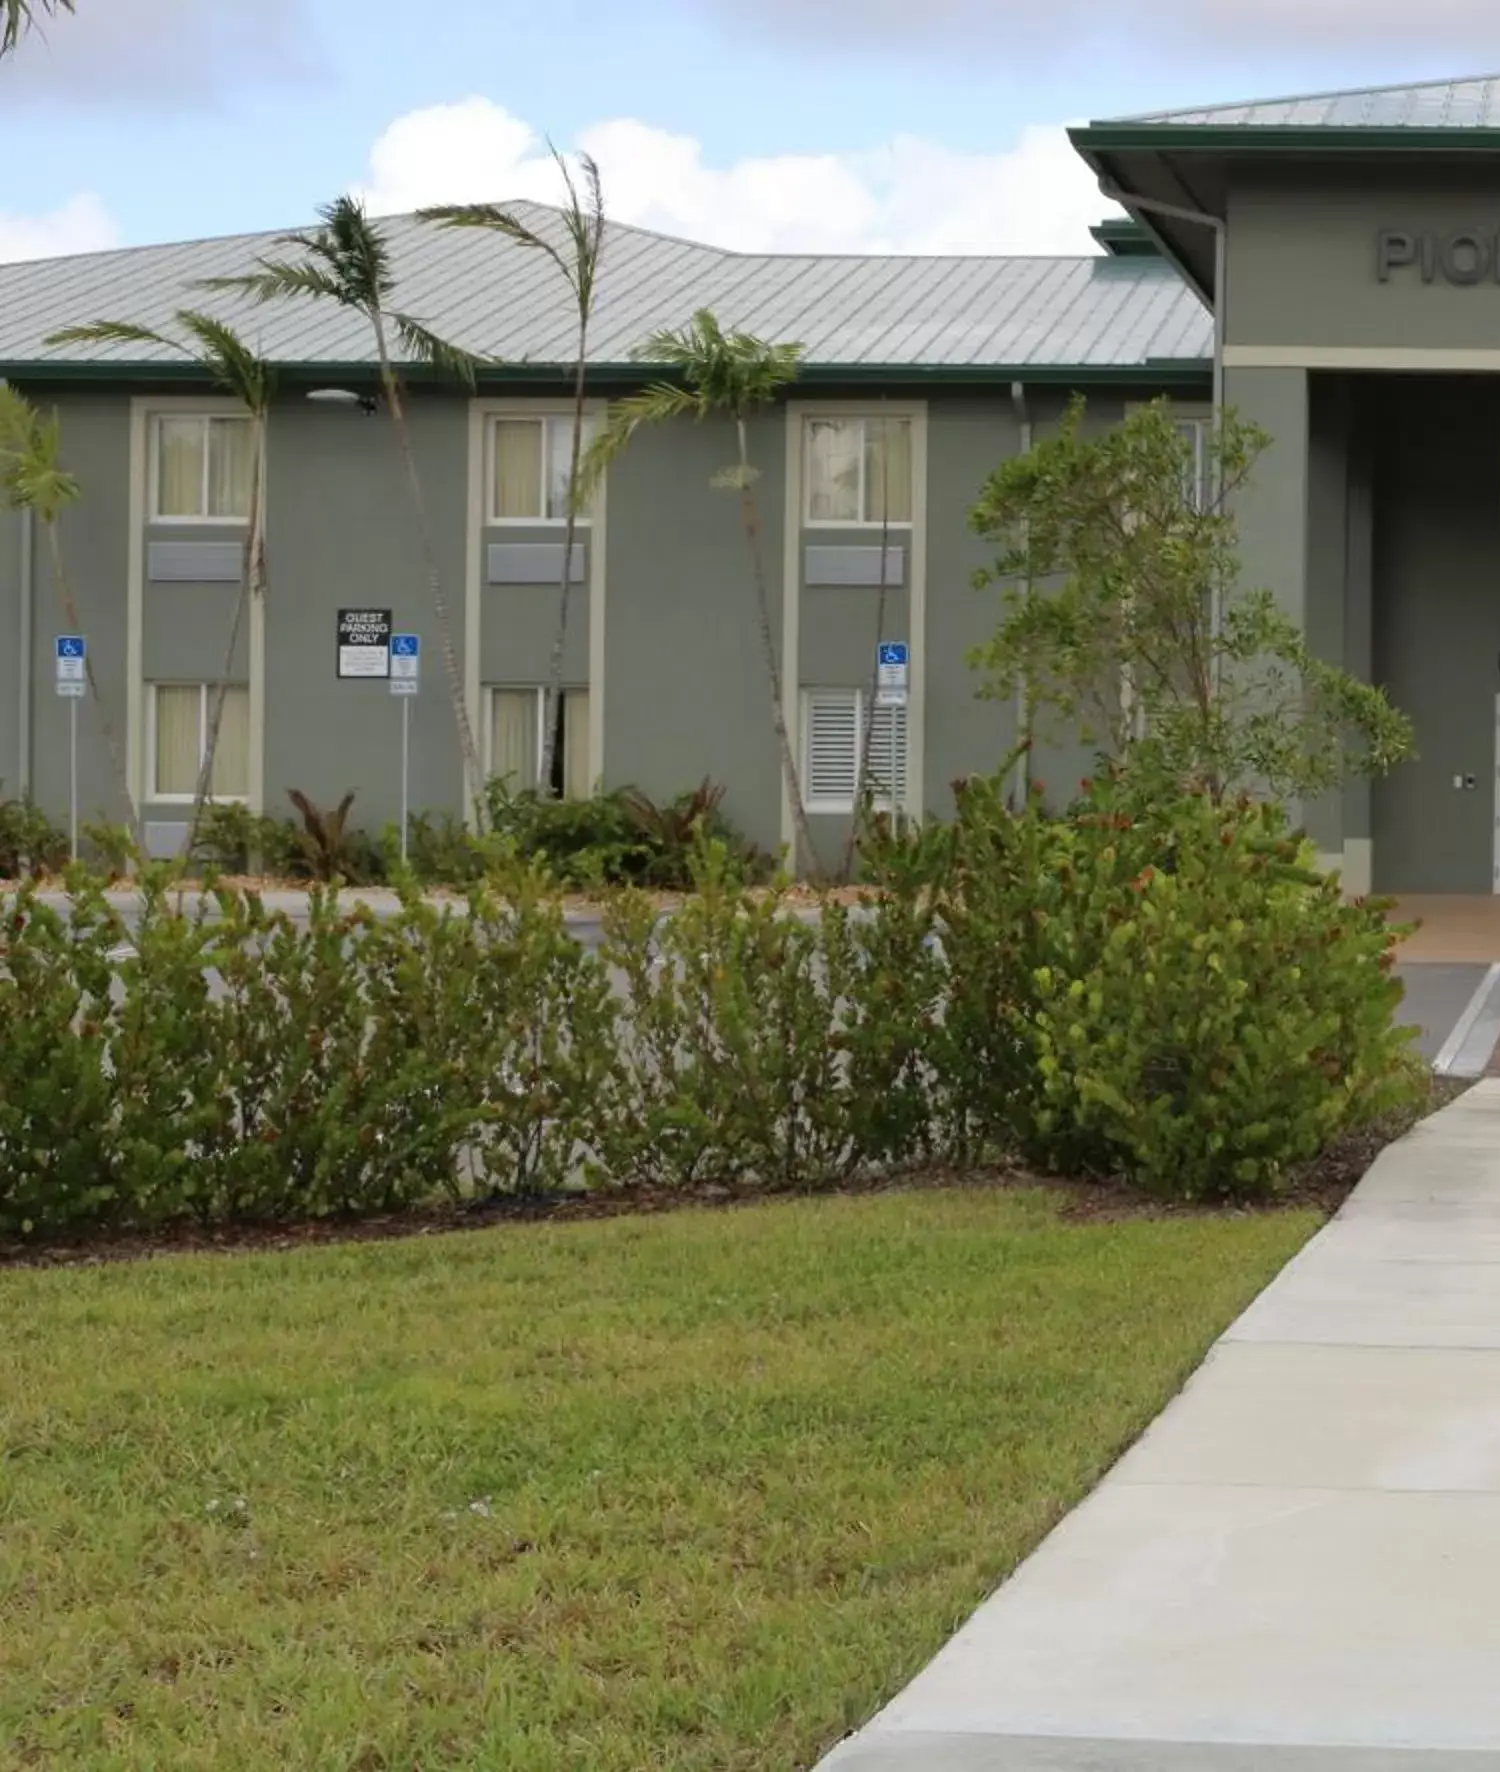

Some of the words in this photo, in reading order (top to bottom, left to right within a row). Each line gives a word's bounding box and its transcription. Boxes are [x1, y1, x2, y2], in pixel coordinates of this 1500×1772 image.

[346, 613, 384, 623] GUEST
[340, 623, 389, 633] PARKING
[349, 633, 379, 643] ONLY
